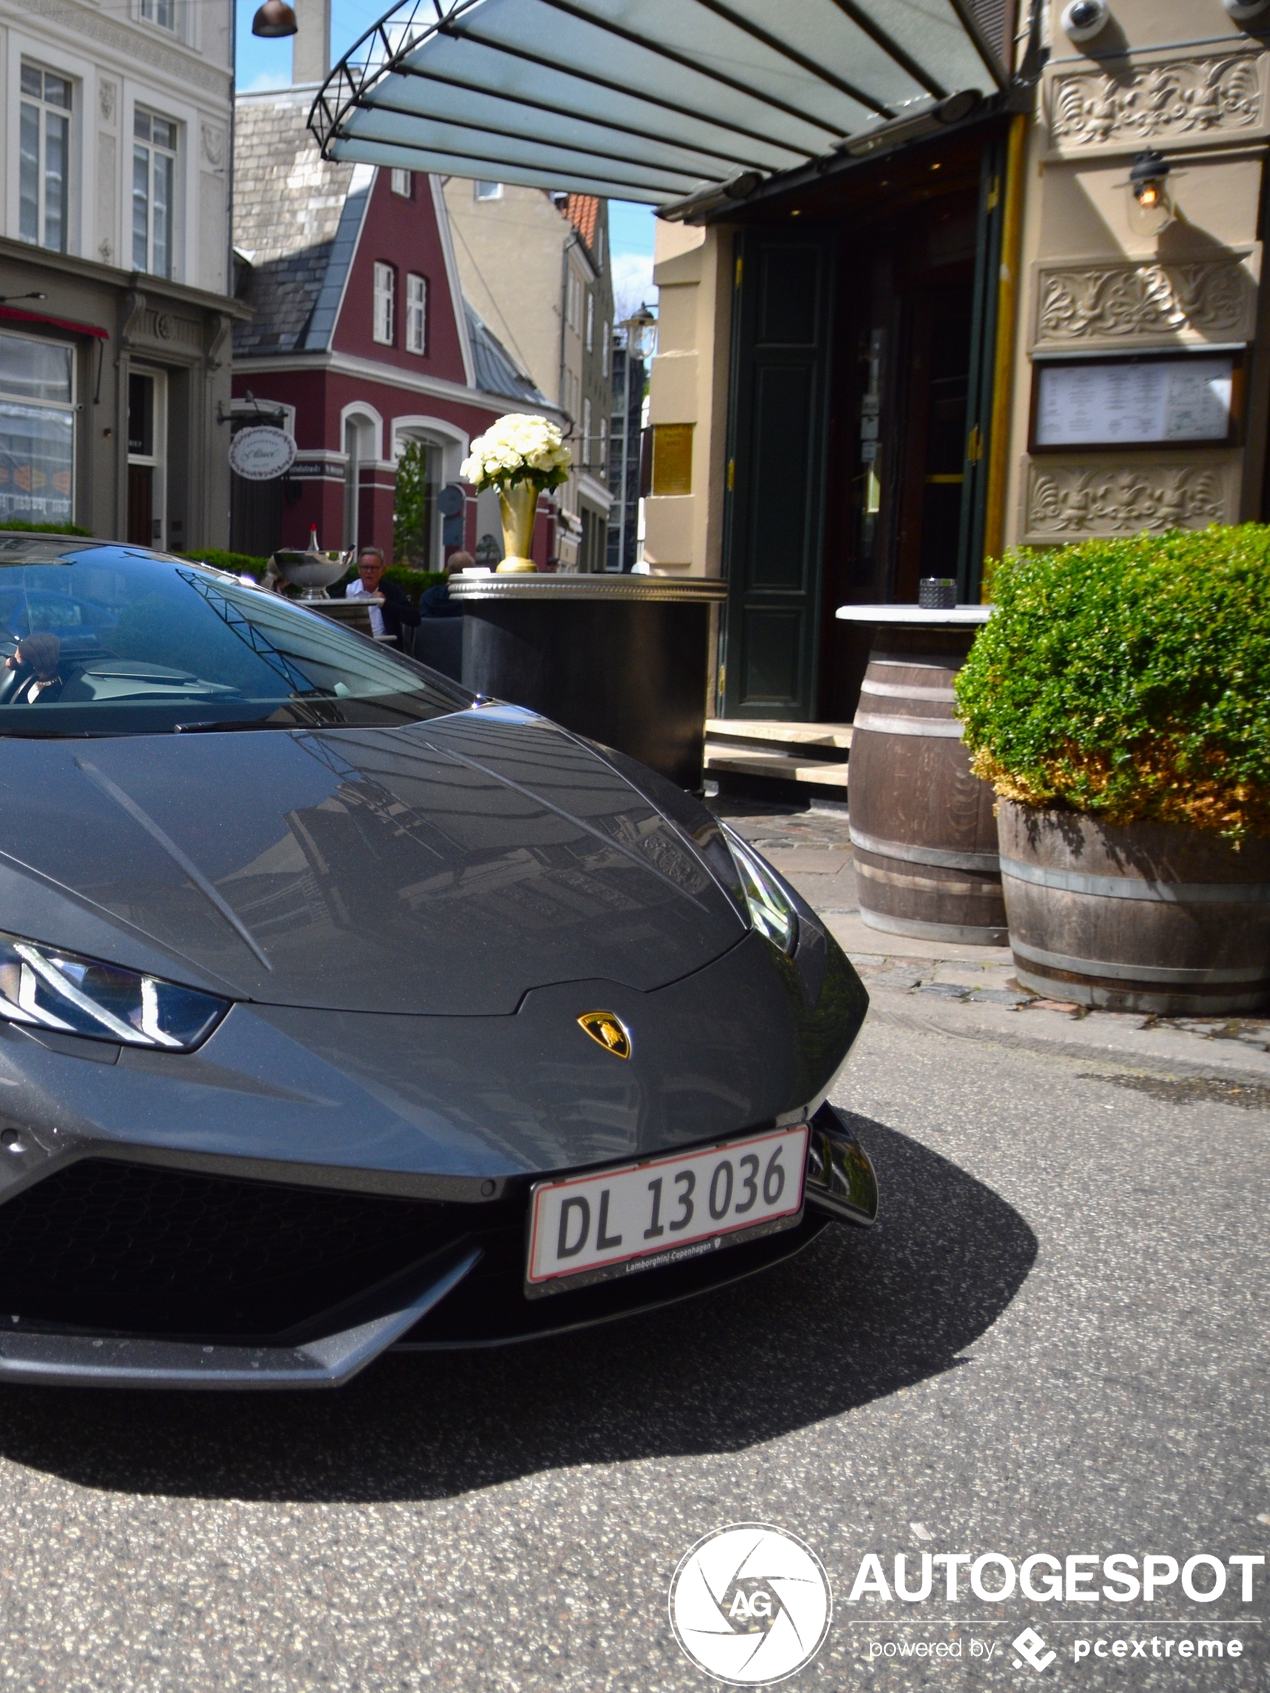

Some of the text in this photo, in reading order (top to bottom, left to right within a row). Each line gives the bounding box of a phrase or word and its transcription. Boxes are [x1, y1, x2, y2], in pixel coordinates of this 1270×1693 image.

[556, 1145, 786, 1260] DL 13 036
[626, 1242, 711, 1272] Lamborghini Copenhagen
